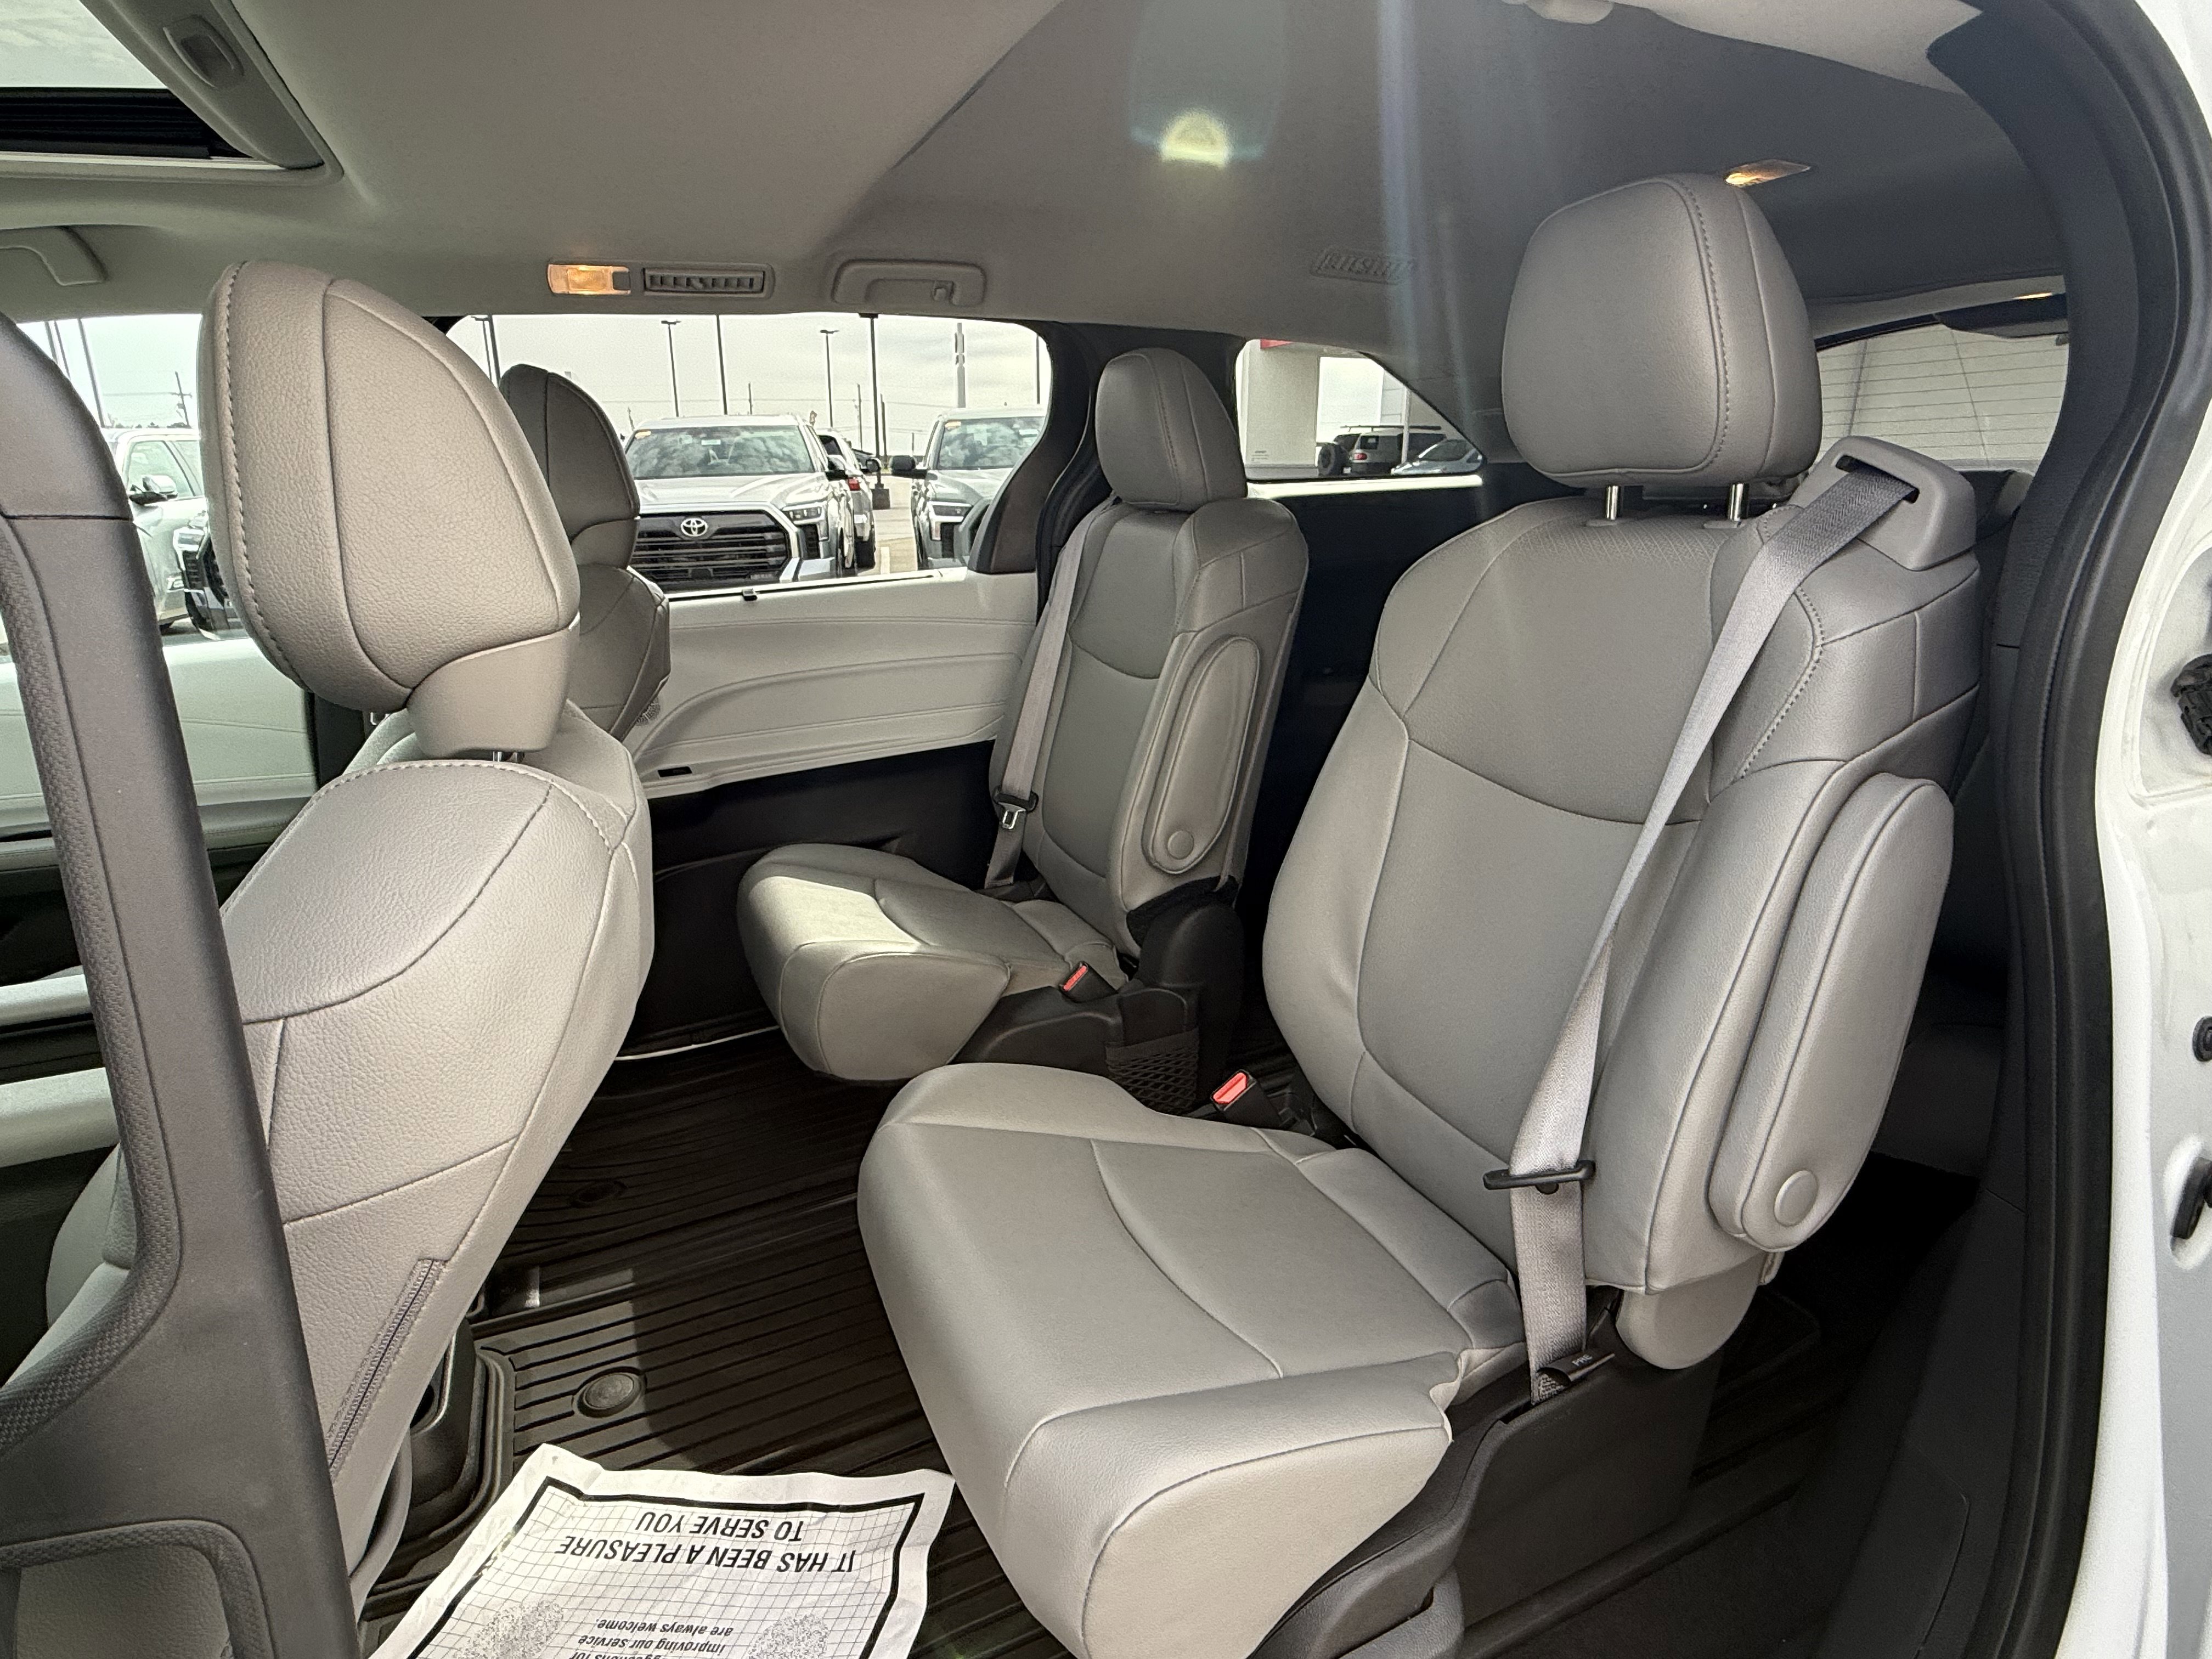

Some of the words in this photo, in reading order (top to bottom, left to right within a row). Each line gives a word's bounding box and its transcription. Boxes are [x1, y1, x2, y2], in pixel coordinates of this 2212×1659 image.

[635, 1511, 686, 1533] YOU
[689, 1515, 769, 1538] SERVE
[774, 1521, 804, 1542] TO
[554, 1535, 682, 1564] PLEASURE
[686, 1544, 706, 1565] A
[706, 1546, 773, 1570] BEEN
[777, 1552, 829, 1572] HAS
[831, 1549, 856, 1572] IT
[596, 1618, 657, 1633] welcome.
[659, 1622, 708, 1636] always
[710, 1626, 733, 1637] are
[578, 1635, 628, 1648] service
[629, 1639, 653, 1649] our
[657, 1638, 726, 1656] improving
